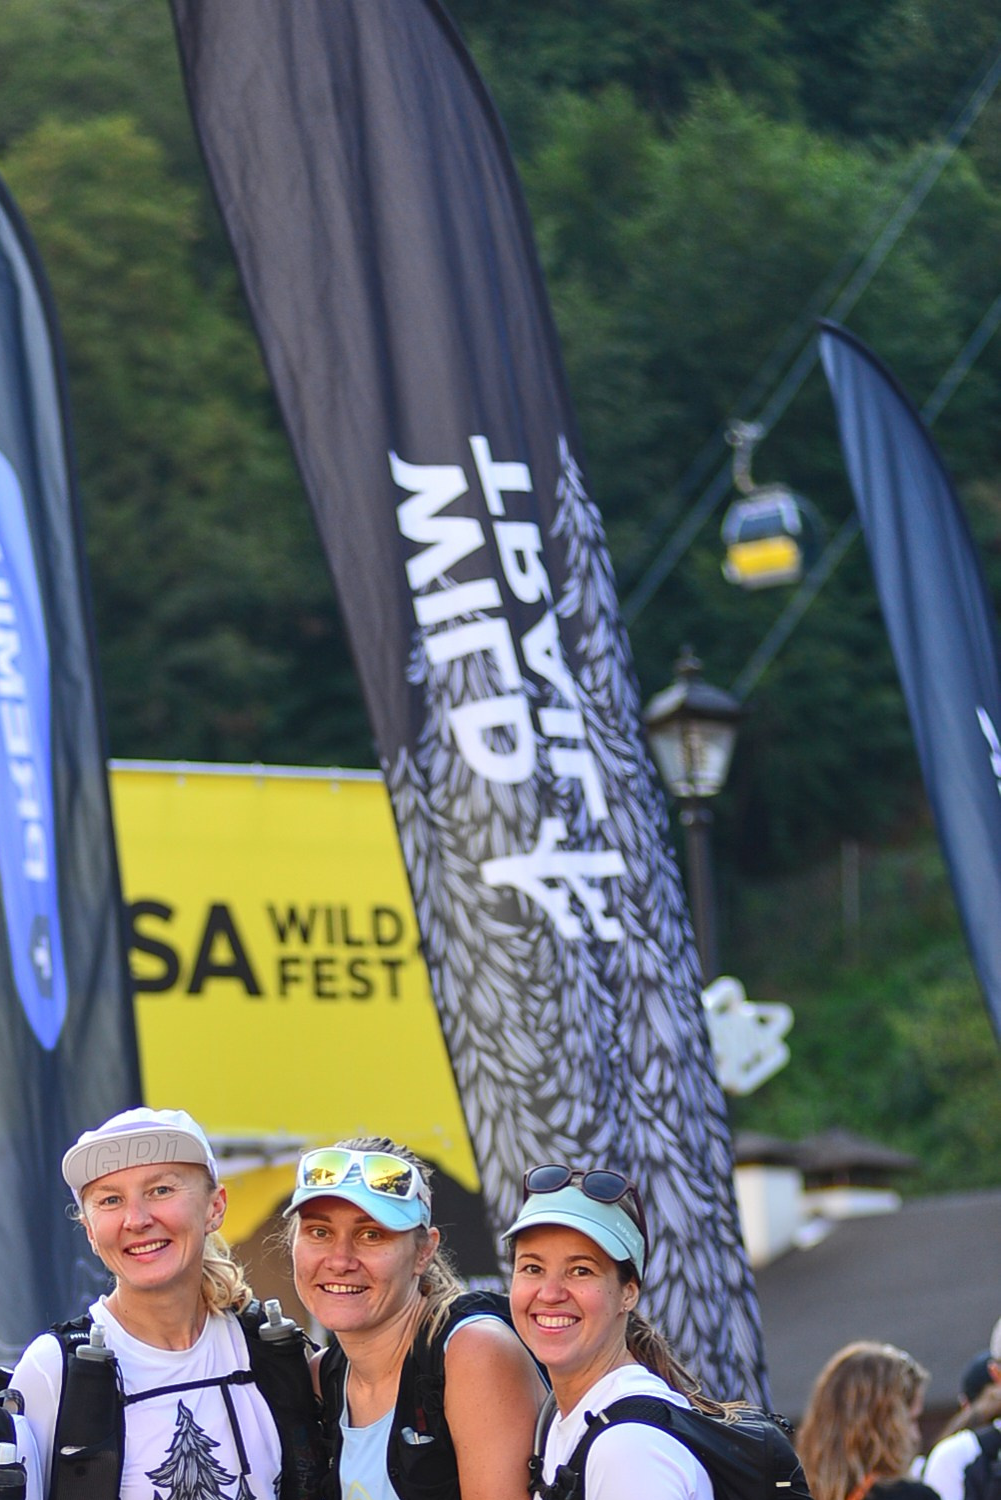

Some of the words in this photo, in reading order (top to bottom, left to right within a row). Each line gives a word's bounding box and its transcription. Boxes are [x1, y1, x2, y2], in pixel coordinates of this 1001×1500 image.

[129, 900, 262, 997] SA
[268, 906, 404, 948] WILD
[280, 957, 405, 1000] FEST
